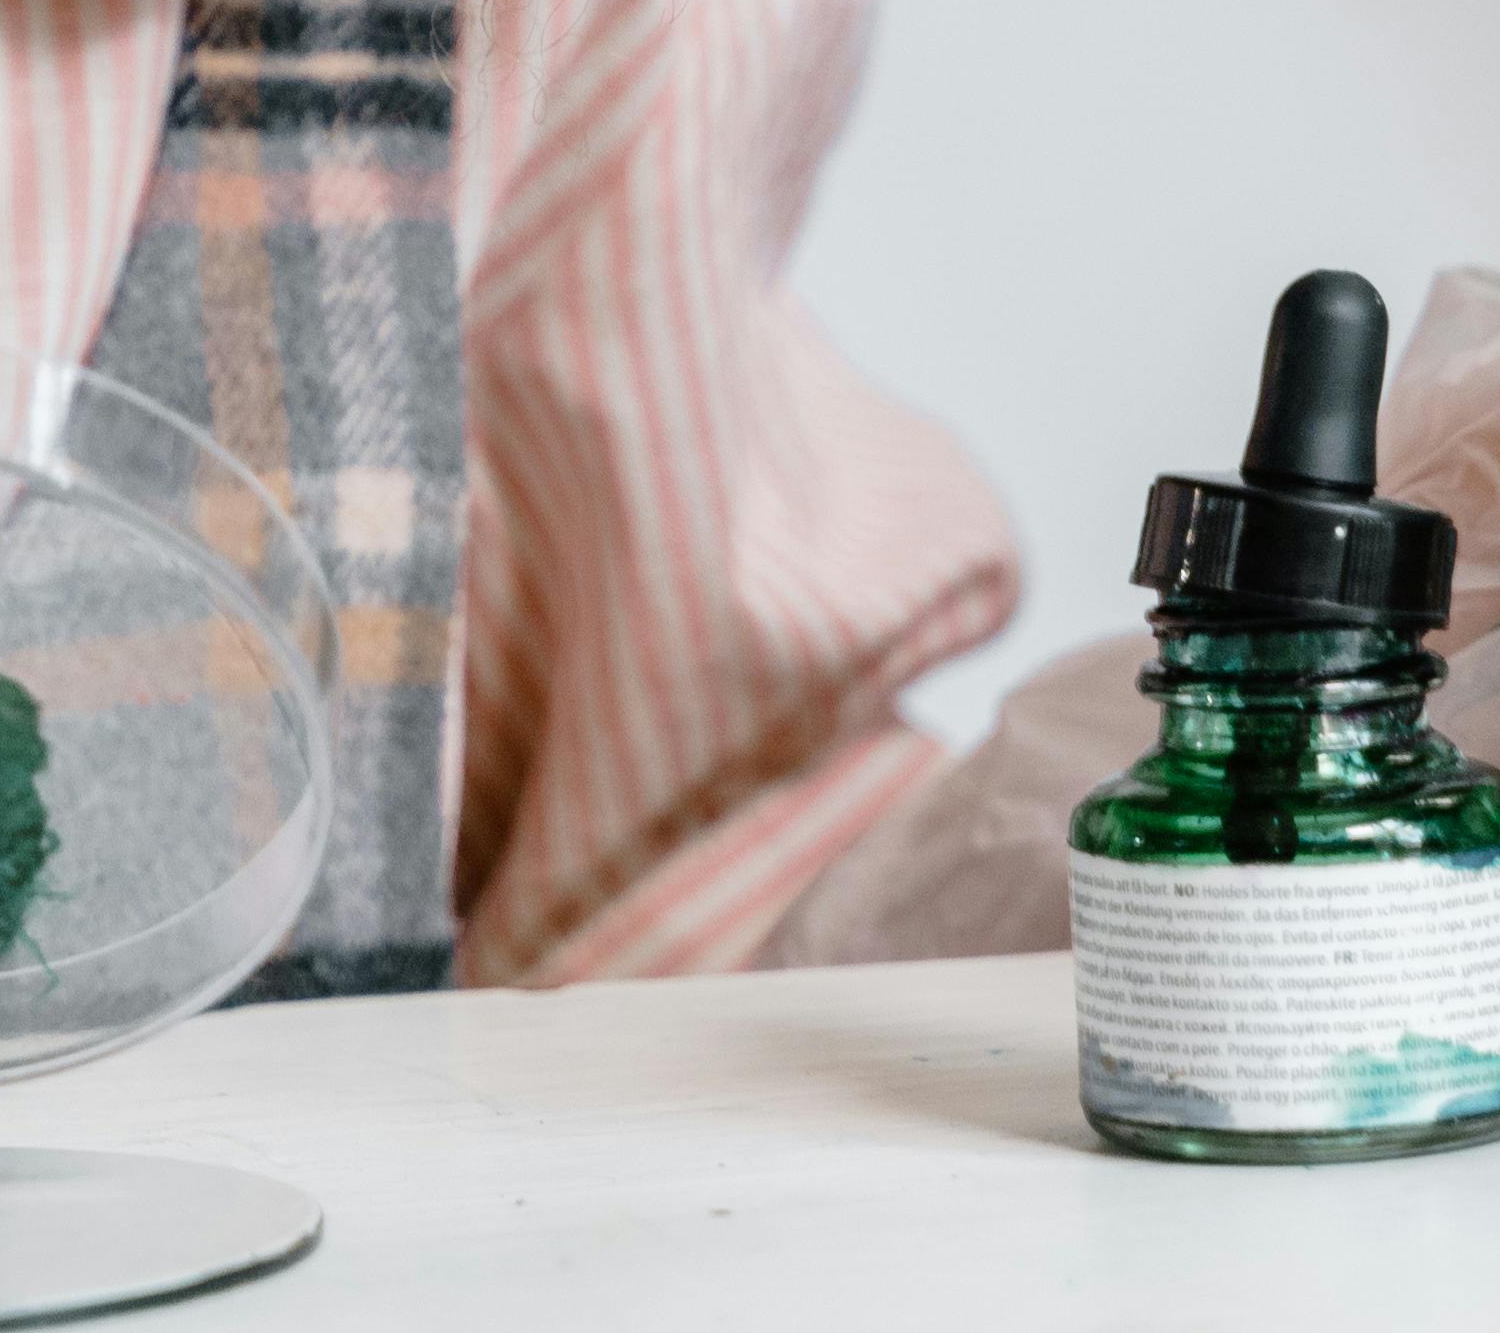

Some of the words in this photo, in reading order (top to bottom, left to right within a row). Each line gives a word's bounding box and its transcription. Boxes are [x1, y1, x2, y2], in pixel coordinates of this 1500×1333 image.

[1173, 883, 1198, 898] NO:
[1201, 884, 1247, 899] Holdes
[1251, 884, 1291, 899] borte
[1292, 884, 1313, 898] fra
[1123, 900, 1171, 923] Kleidung
[1251, 908, 1270, 922] da
[1272, 908, 1299, 922] das
[1301, 906, 1373, 921] Entfernen
[1154, 927, 1200, 946] alejado
[1202, 930, 1220, 944] de
[1221, 930, 1242, 945] los
[1243, 930, 1279, 948] ojos.
[1282, 929, 1317, 944] Evita
[1320, 928, 1333, 943] el
[1335, 924, 1397, 942] contacto
[1425, 920, 1436, 935] la
[1145, 950, 1182, 965] essere
[1183, 951, 1228, 967] difficili
[1231, 953, 1249, 967] da
[1251, 953, 1329, 967] rimuovere.
[1333, 949, 1358, 965] FR:
[1360, 947, 1391, 963] Tenir
[1406, 940, 1457, 958] distance
[1202, 978, 1215, 989] οι
[1218, 975, 1273, 992] λεκέδες
[1171, 994, 1229, 1012] kontakto
[1231, 1001, 1248, 1012] su
[1285, 995, 1356, 1012] Patieskite
[1154, 1040, 1179, 1054] com
[1181, 1043, 1189, 1054] a
[1226, 1042, 1287, 1060] Proteger
[1289, 1046, 1300, 1057] o
[1290, 1063, 1345, 1082] plachtu
[1347, 1065, 1366, 1077] na
[1262, 1091, 1289, 1105] egy
